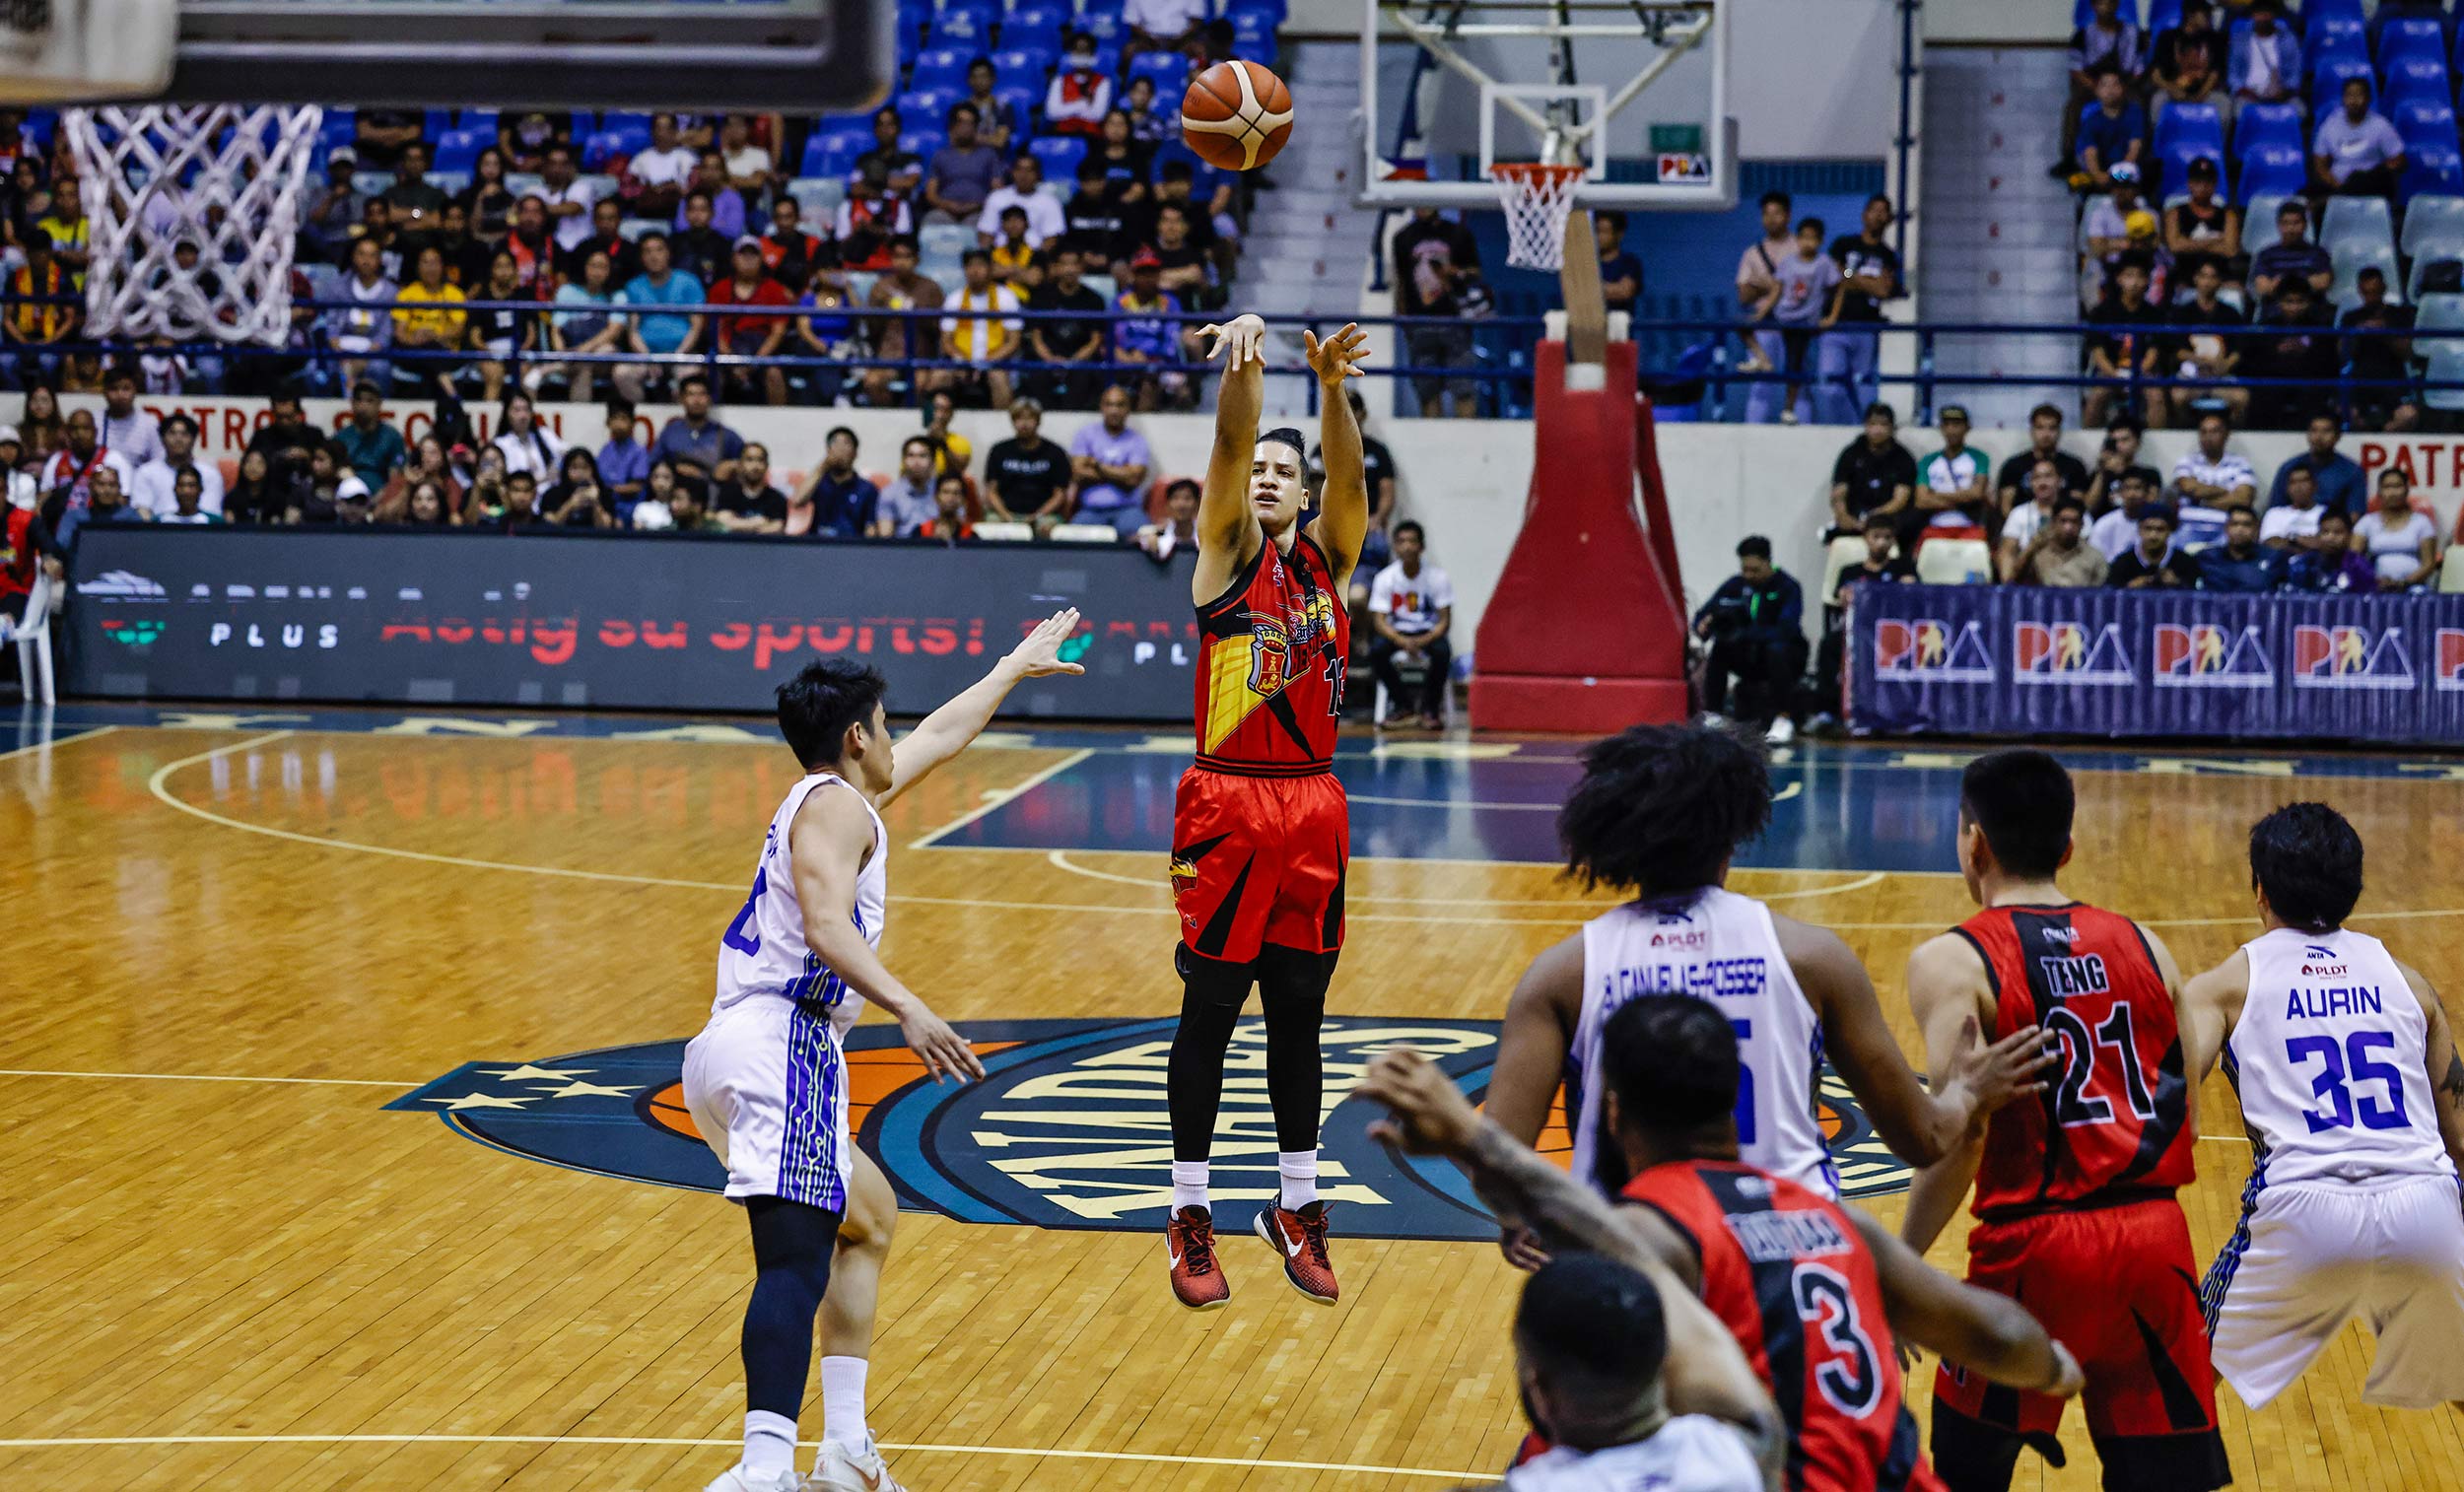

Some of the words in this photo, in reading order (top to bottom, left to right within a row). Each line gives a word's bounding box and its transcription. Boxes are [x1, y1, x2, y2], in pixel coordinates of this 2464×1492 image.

[209, 622, 339, 648] PLUS
[1133, 641, 1191, 666] PL
[1875, 619, 1996, 683] PBA
[2014, 621, 2136, 685] PBA
[2154, 623, 2275, 688] PBA
[2293, 625, 2416, 689] PBA
[2039, 952, 2111, 997] TENG
[2315, 965, 2349, 976] PLDT
[2286, 985, 2382, 1021] AURIN
[2042, 1000, 2156, 1128] 21
[2285, 1031, 2414, 1135] 35
[1791, 1261, 1882, 1420] 3
